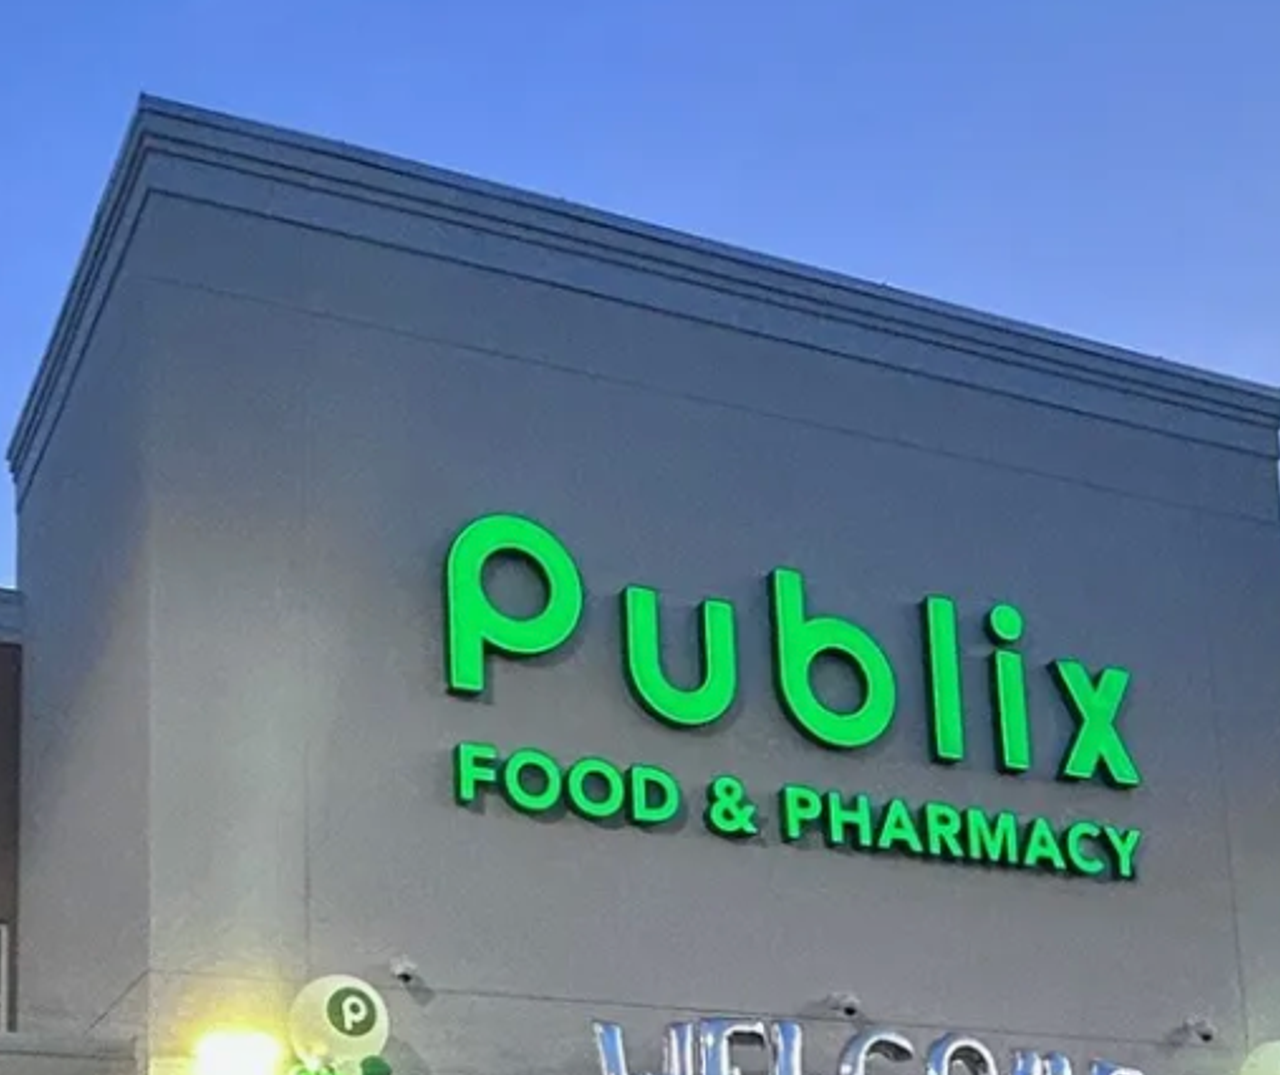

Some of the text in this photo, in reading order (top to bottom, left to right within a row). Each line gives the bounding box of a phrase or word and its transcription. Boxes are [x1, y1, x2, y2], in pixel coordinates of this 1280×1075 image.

[447, 514, 1140, 787] Publix
[458, 743, 1141, 879] FOOD & PHARMACY
